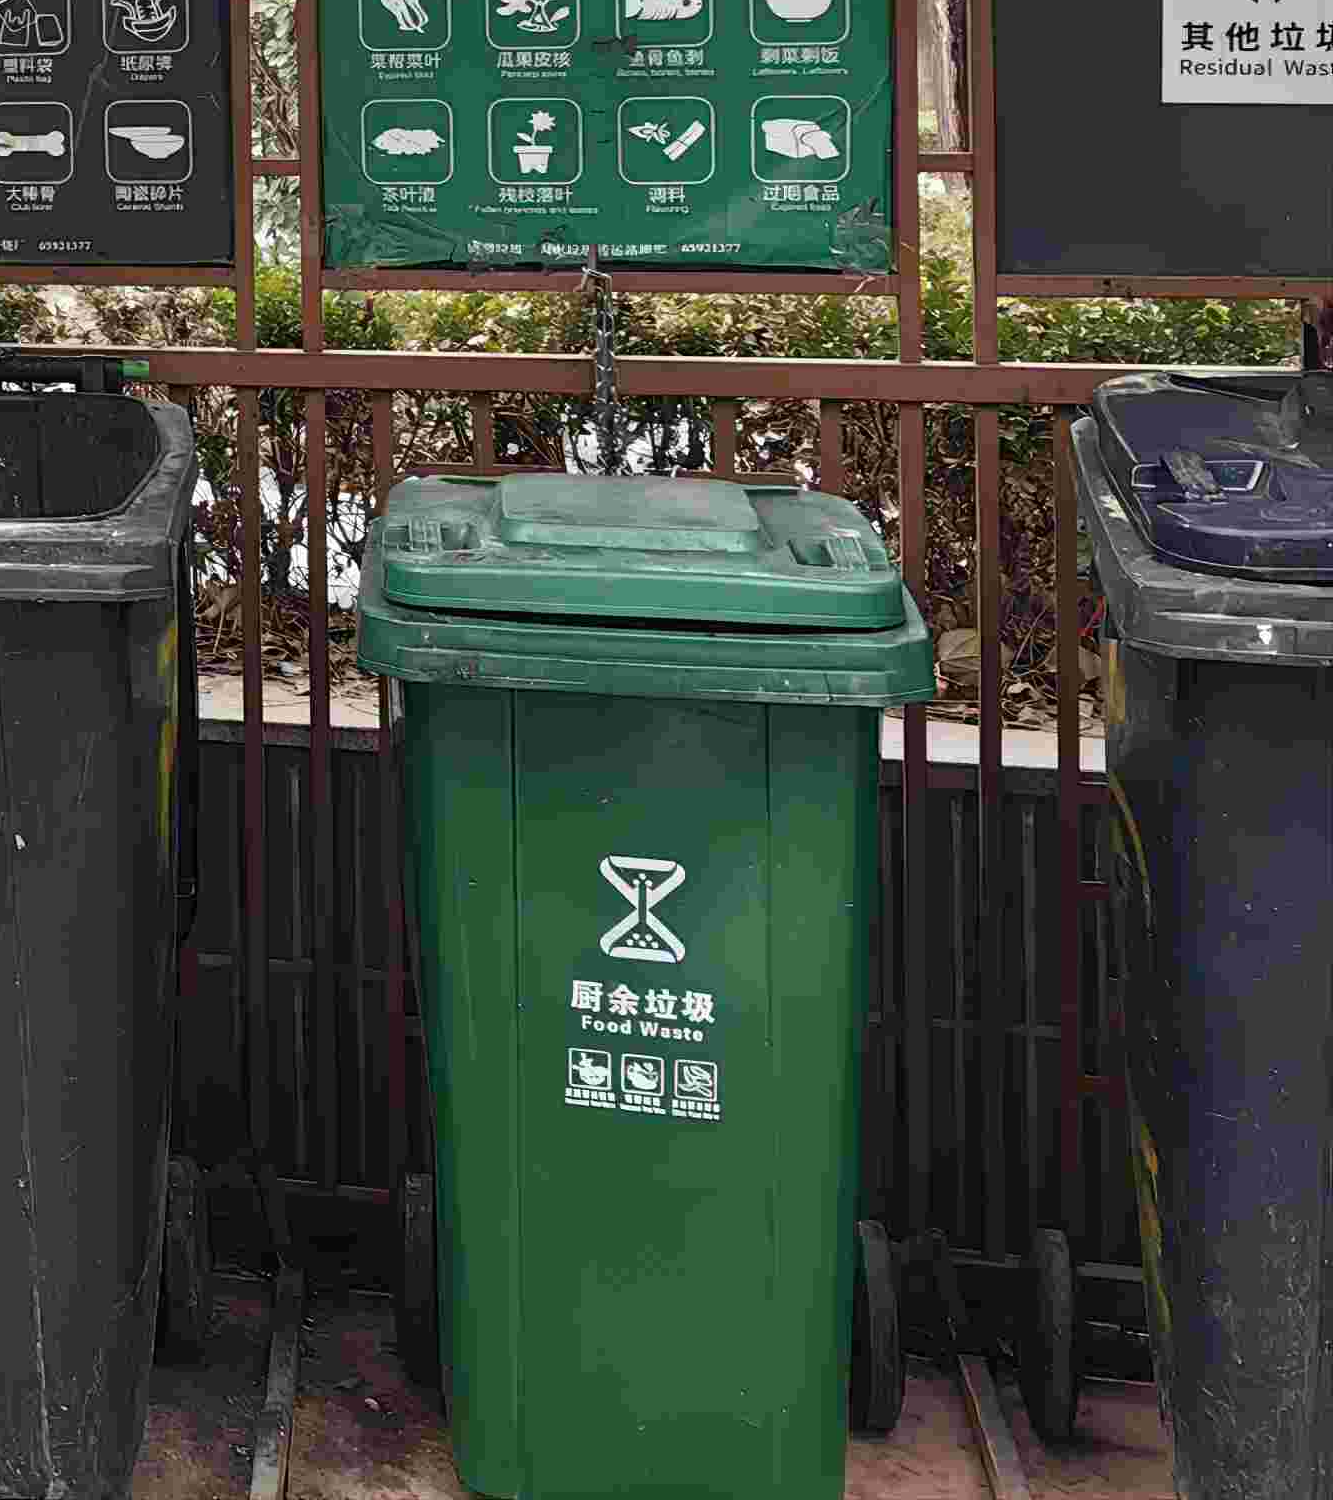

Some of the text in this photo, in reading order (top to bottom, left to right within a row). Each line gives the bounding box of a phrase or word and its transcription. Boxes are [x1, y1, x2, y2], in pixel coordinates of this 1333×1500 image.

[1180, 58, 1272, 77] Residual
[571, 979, 715, 1024] 厨余垃圾
[581, 1015, 704, 1042] Food Waste
